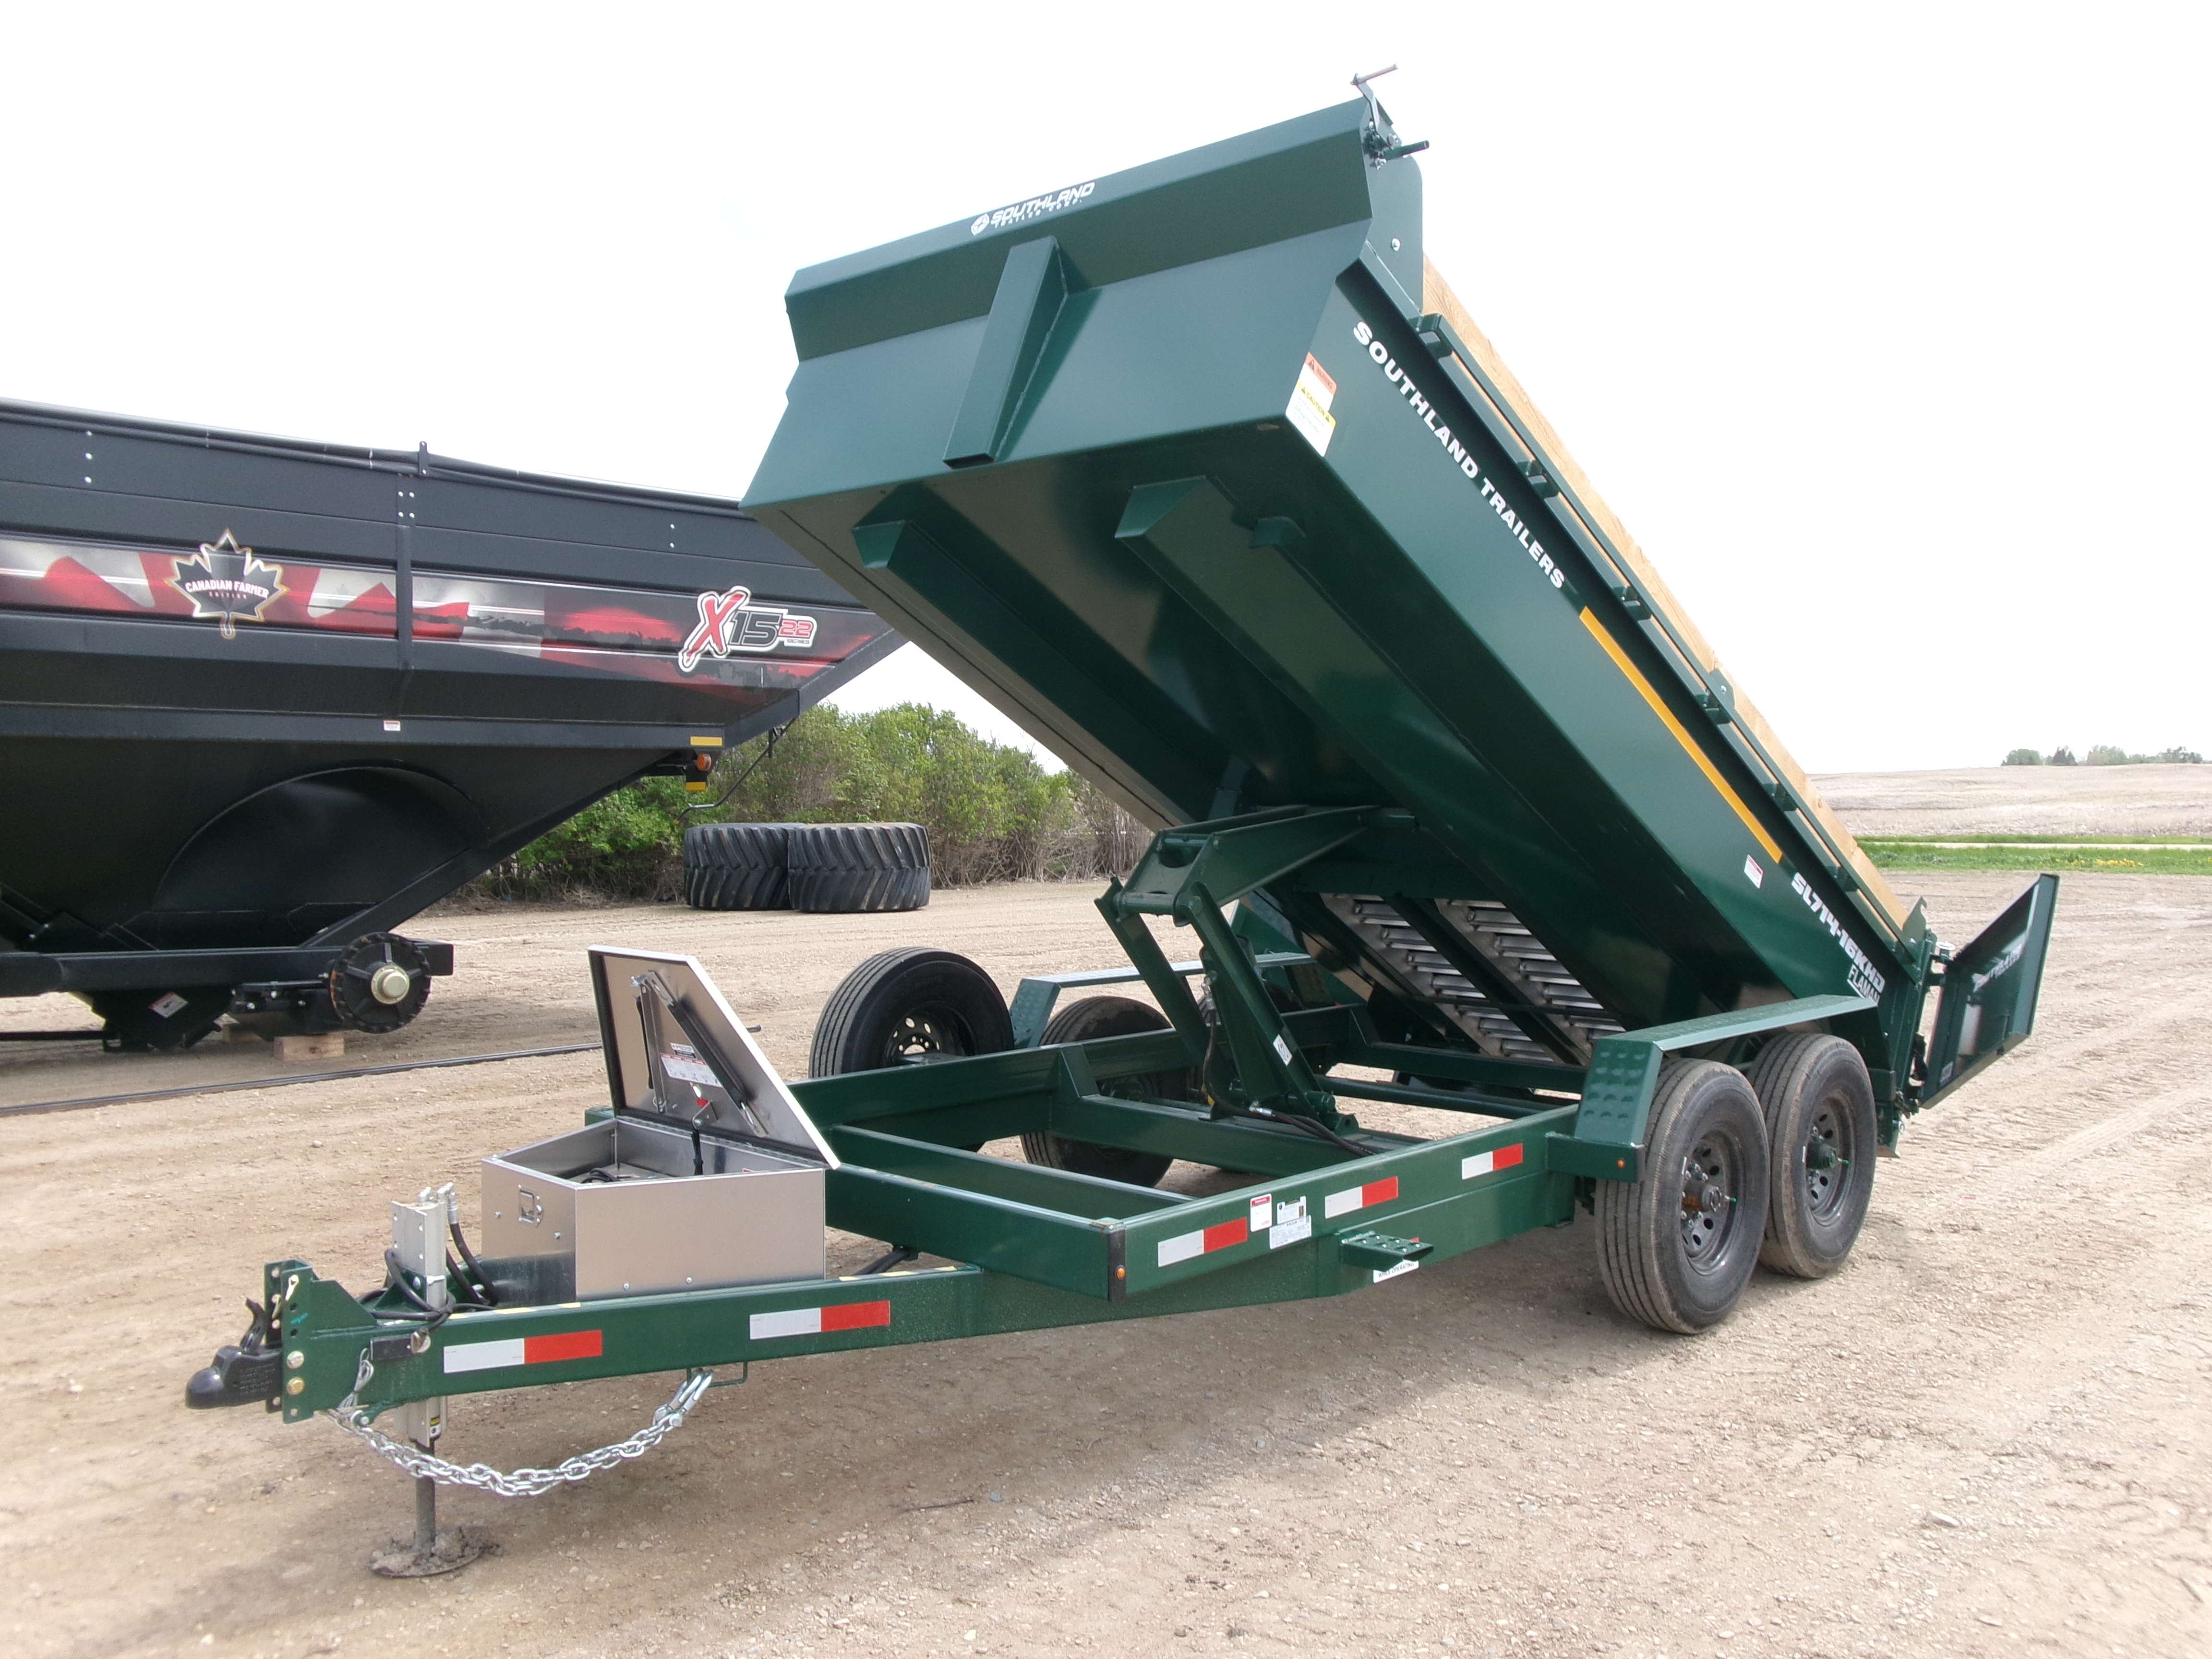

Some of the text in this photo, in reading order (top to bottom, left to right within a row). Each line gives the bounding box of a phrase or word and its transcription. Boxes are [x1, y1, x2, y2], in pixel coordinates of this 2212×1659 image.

[991, 182, 1095, 224] SOUTHLAND
[1306, 392, 1325, 417] CAUTION
[1352, 321, 1565, 589] SOUTHLAND TRAILERS
[185, 579, 269, 599] CANADIAN FARMER
[1848, 963, 1880, 1005] FLAMAN
